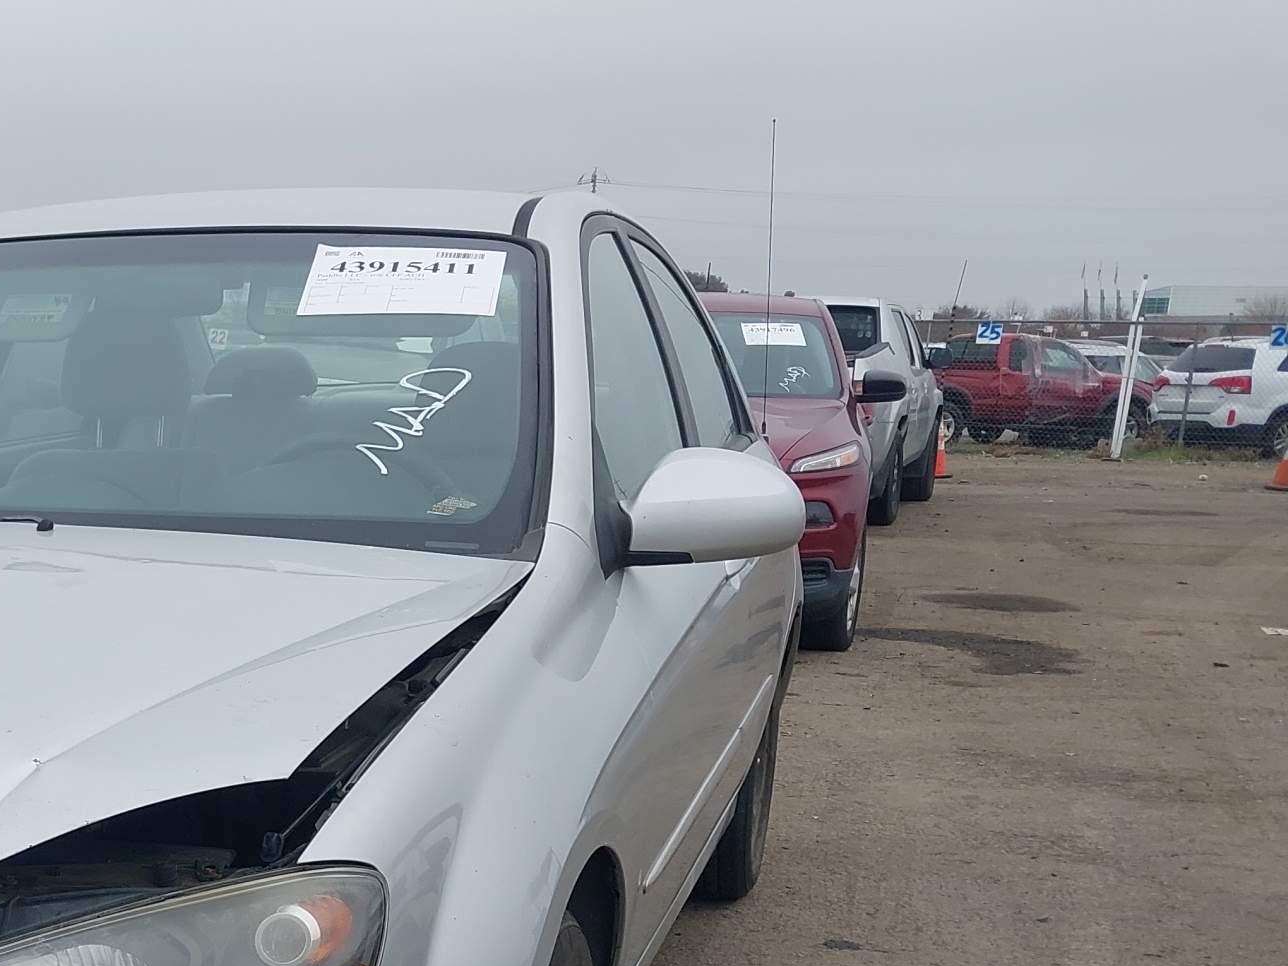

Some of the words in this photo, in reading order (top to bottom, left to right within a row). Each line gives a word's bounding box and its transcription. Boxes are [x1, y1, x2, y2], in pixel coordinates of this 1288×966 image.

[329, 260, 476, 275] 43915411
[210, 330, 226, 345] 22
[978, 321, 1002, 341] 25
[1271, 327, 1288, 347] 2
